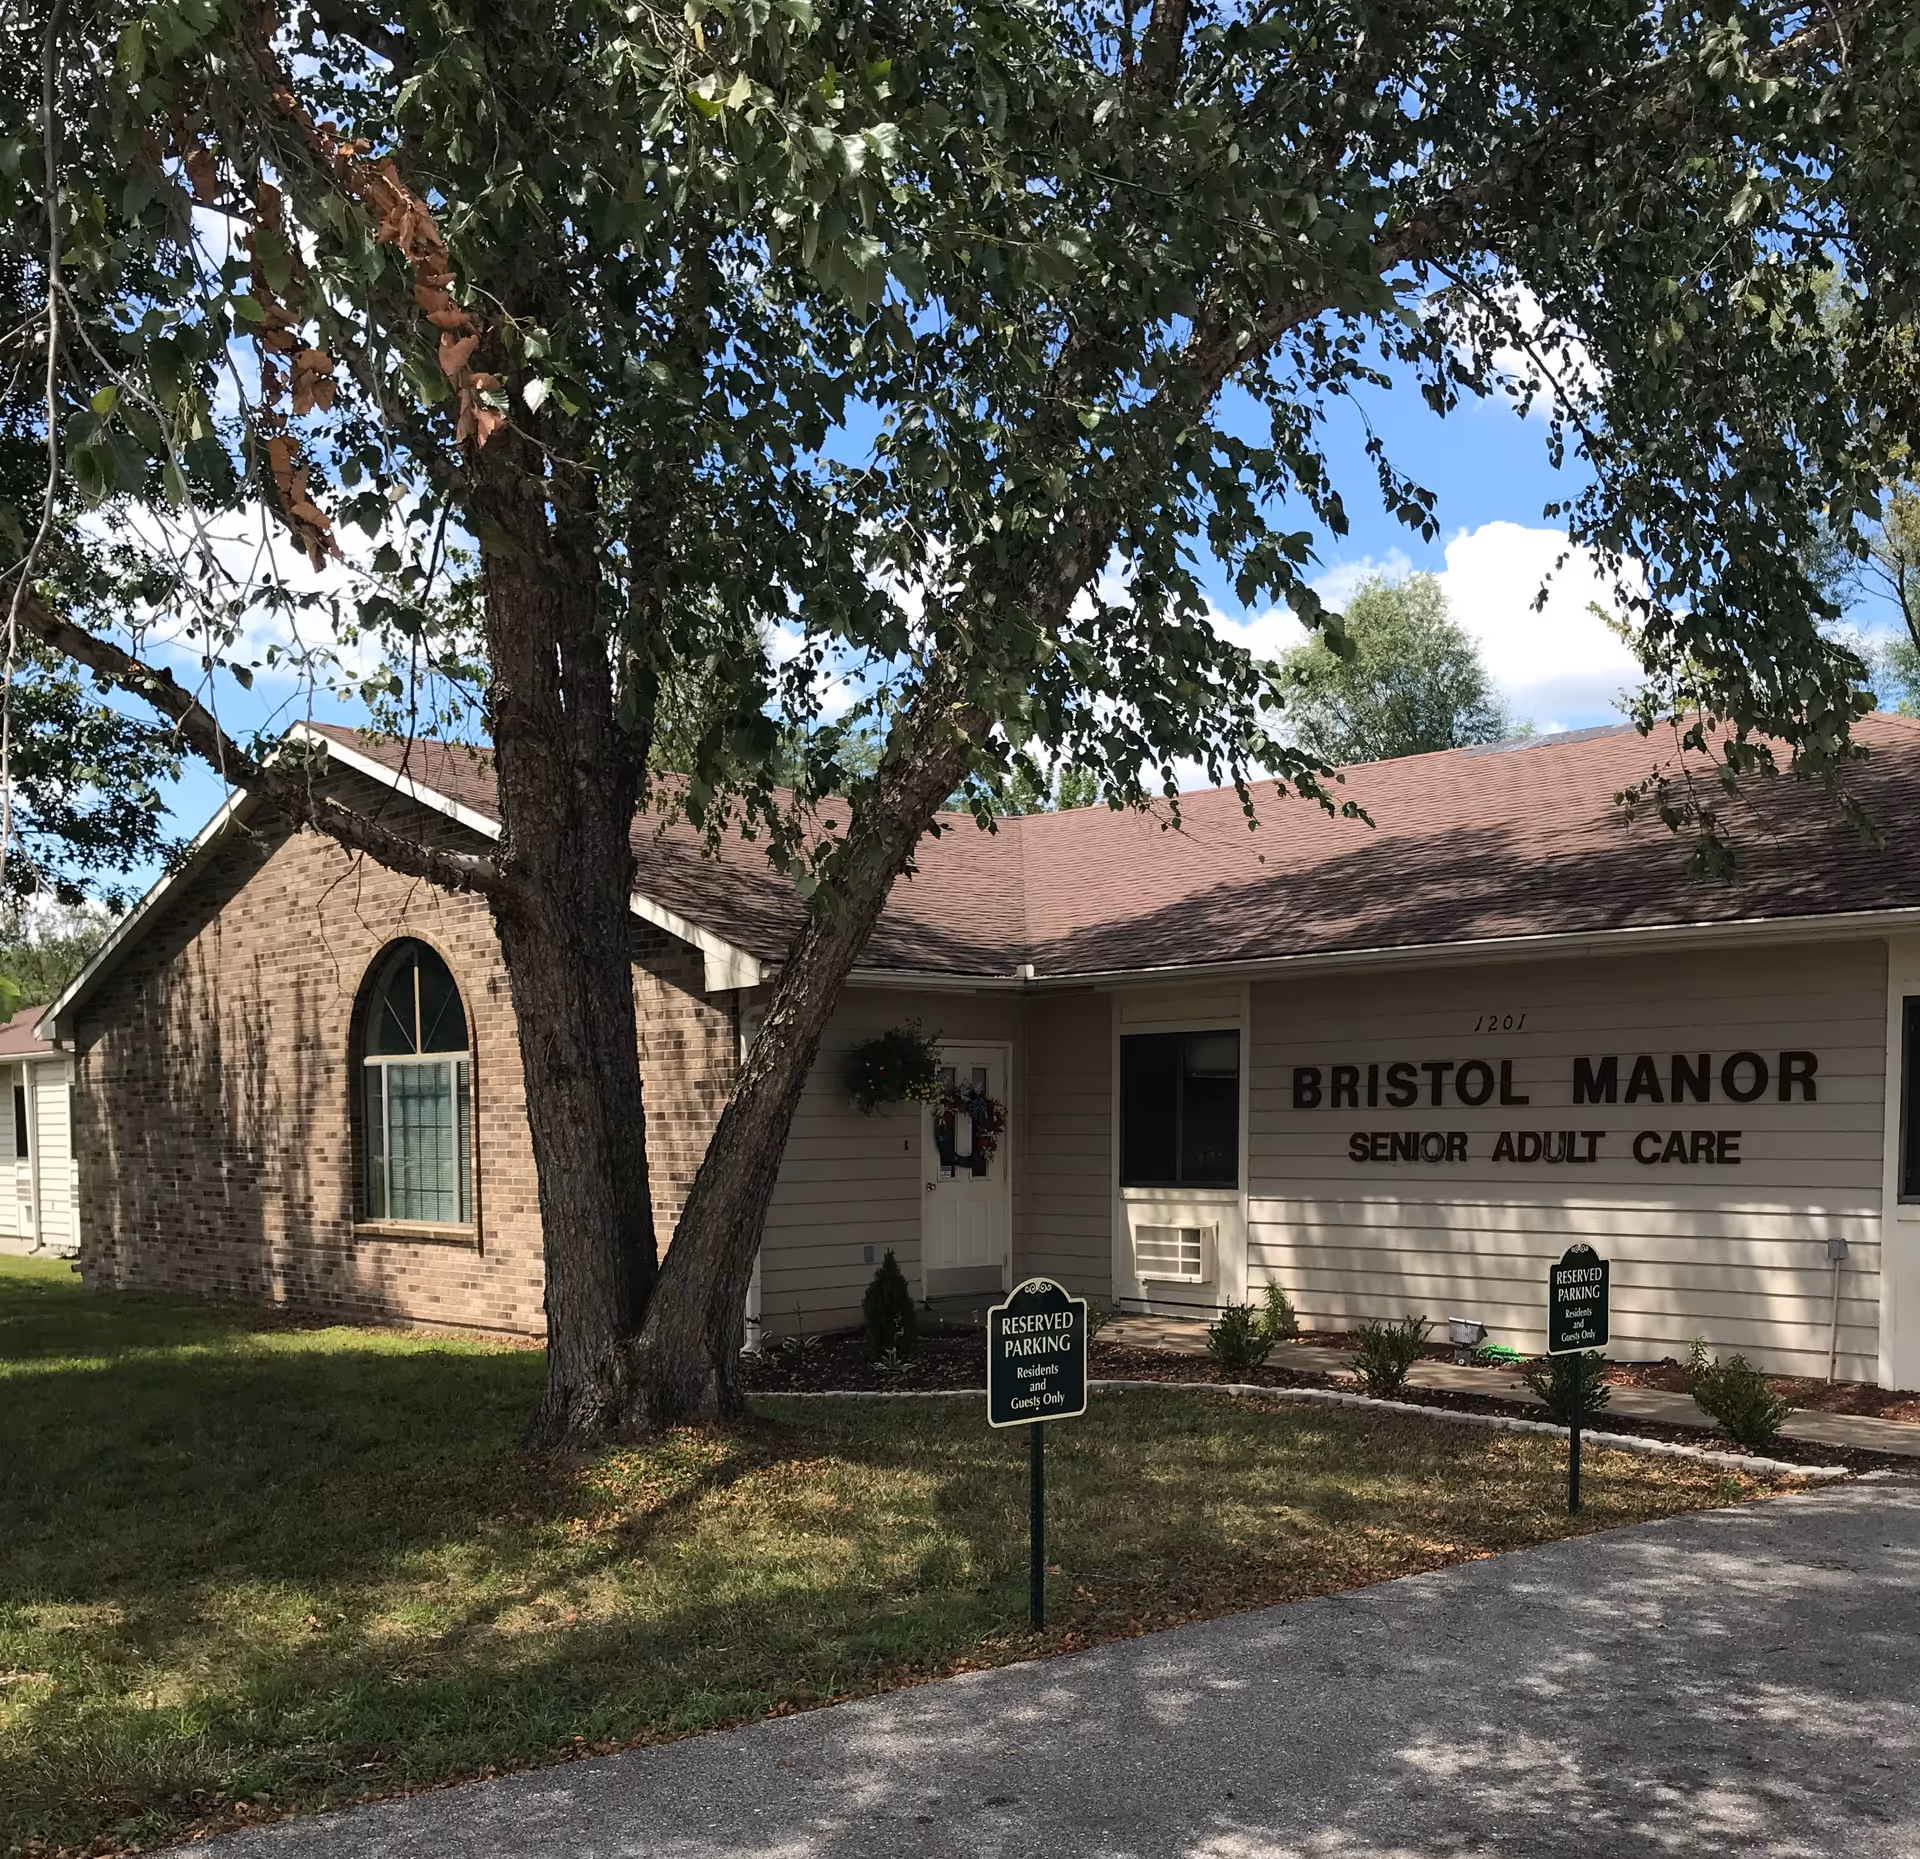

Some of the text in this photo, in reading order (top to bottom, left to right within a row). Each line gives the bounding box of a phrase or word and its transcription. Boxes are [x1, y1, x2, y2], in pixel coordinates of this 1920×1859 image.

[1474, 1013, 1527, 1032] 1201
[1292, 1050, 1819, 1109] BRISTOL MANOR
[1348, 1129, 1742, 1165] SENIOR ADULT CARE
[1556, 1267, 1603, 1285] RESERVED
[1558, 1284, 1600, 1303] PARKING
[1565, 1307, 1593, 1319] Residents
[1002, 1311, 1074, 1335] RESERVED
[1573, 1318, 1584, 1329] and
[1561, 1328, 1597, 1342] Guests Only
[1005, 1333, 1071, 1358] PARKING
[1017, 1363, 1059, 1379] Residents
[1029, 1377, 1047, 1392] and
[1011, 1390, 1065, 1410] Guests Only
